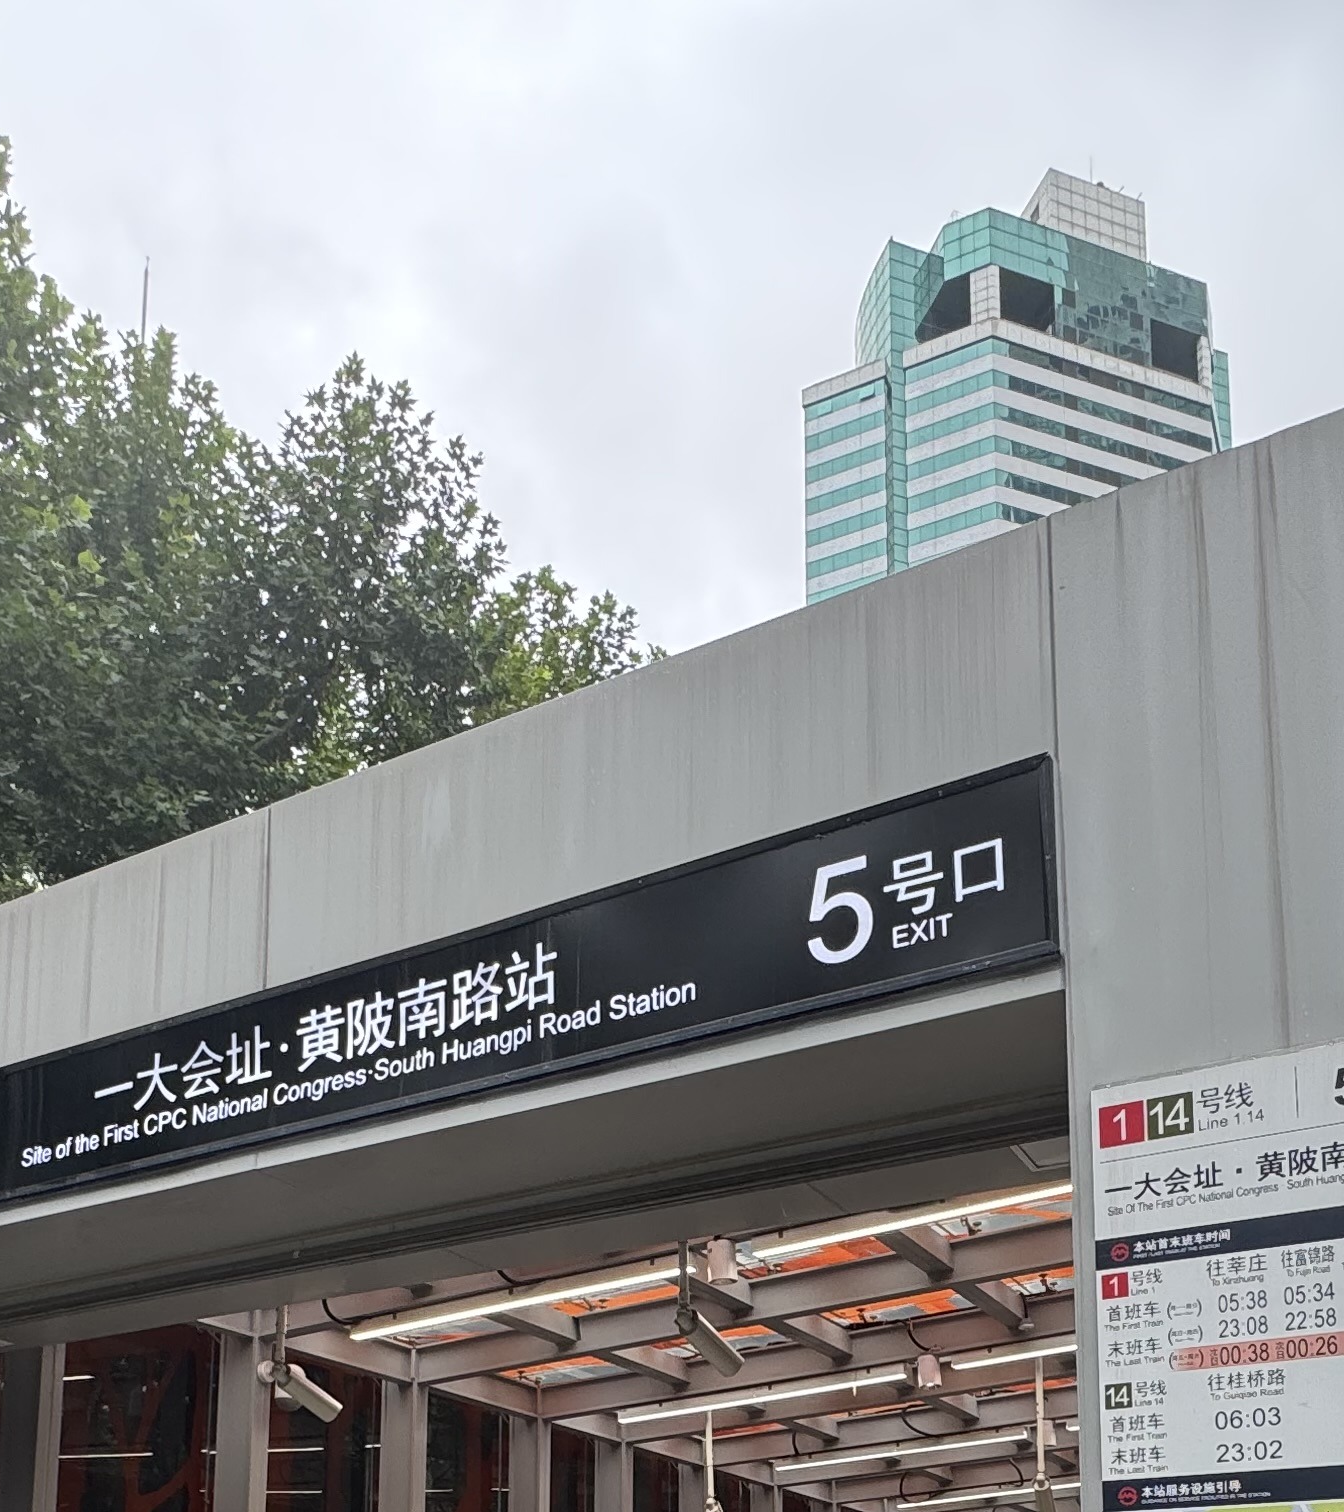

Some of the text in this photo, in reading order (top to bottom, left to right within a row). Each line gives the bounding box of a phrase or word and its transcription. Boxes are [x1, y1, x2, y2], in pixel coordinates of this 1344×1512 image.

[892, 912, 953, 949] EXIT
[20, 1145, 52, 1169] Site
[55, 1137, 72, 1160] of
[74, 1133, 100, 1153] the
[103, 1120, 140, 1148] First
[143, 1108, 187, 1137] CPC
[192, 1088, 268, 1127] National
[441, 1019, 532, 1065] Huangpi
[539, 1001, 601, 1039] Road
[608, 981, 697, 1022] Station
[1112, 1082, 1255, 1142] 1 14 号线
[1198, 1116, 1229, 1132] Line
[1138, 1201, 1154, 1212] The
[1176, 1194, 1196, 1207] CPC
[1198, 1188, 1234, 1203] National
[1287, 1176, 1314, 1190] South
[1133, 1229, 1231, 1253] 本站首末班车时间
[1131, 1268, 1163, 1287] 号线
[1206, 1252, 1268, 1279] 往莘庄
[1211, 1278, 1221, 1287] To
[1283, 1281, 1336, 1305] 05:34
[1106, 1300, 1162, 1322] 首班车
[1218, 1290, 1269, 1313] 05:38
[1218, 1315, 1270, 1339] 23:08
[1285, 1307, 1337, 1331] 22:58
[1107, 1336, 1163, 1358] 末班车
[1219, 1343, 1271, 1366] 00:38
[1286, 1335, 1338, 1359] 00:26
[1207, 1368, 1287, 1392] 往桂桥路
[1105, 1379, 1167, 1408] 14 号线
[1210, 1392, 1220, 1401] To
[1259, 1388, 1285, 1397] Road
[1109, 1413, 1166, 1433] 首班车
[1214, 1406, 1282, 1430] 06:03
[1107, 1435, 1124, 1443] The
[1110, 1445, 1167, 1466] 末班车
[1216, 1439, 1283, 1464] 23:02
[1108, 1467, 1125, 1475] The
[1148, 1464, 1169, 1473] Train
[1140, 1479, 1242, 1499] 本站服务设施引导
